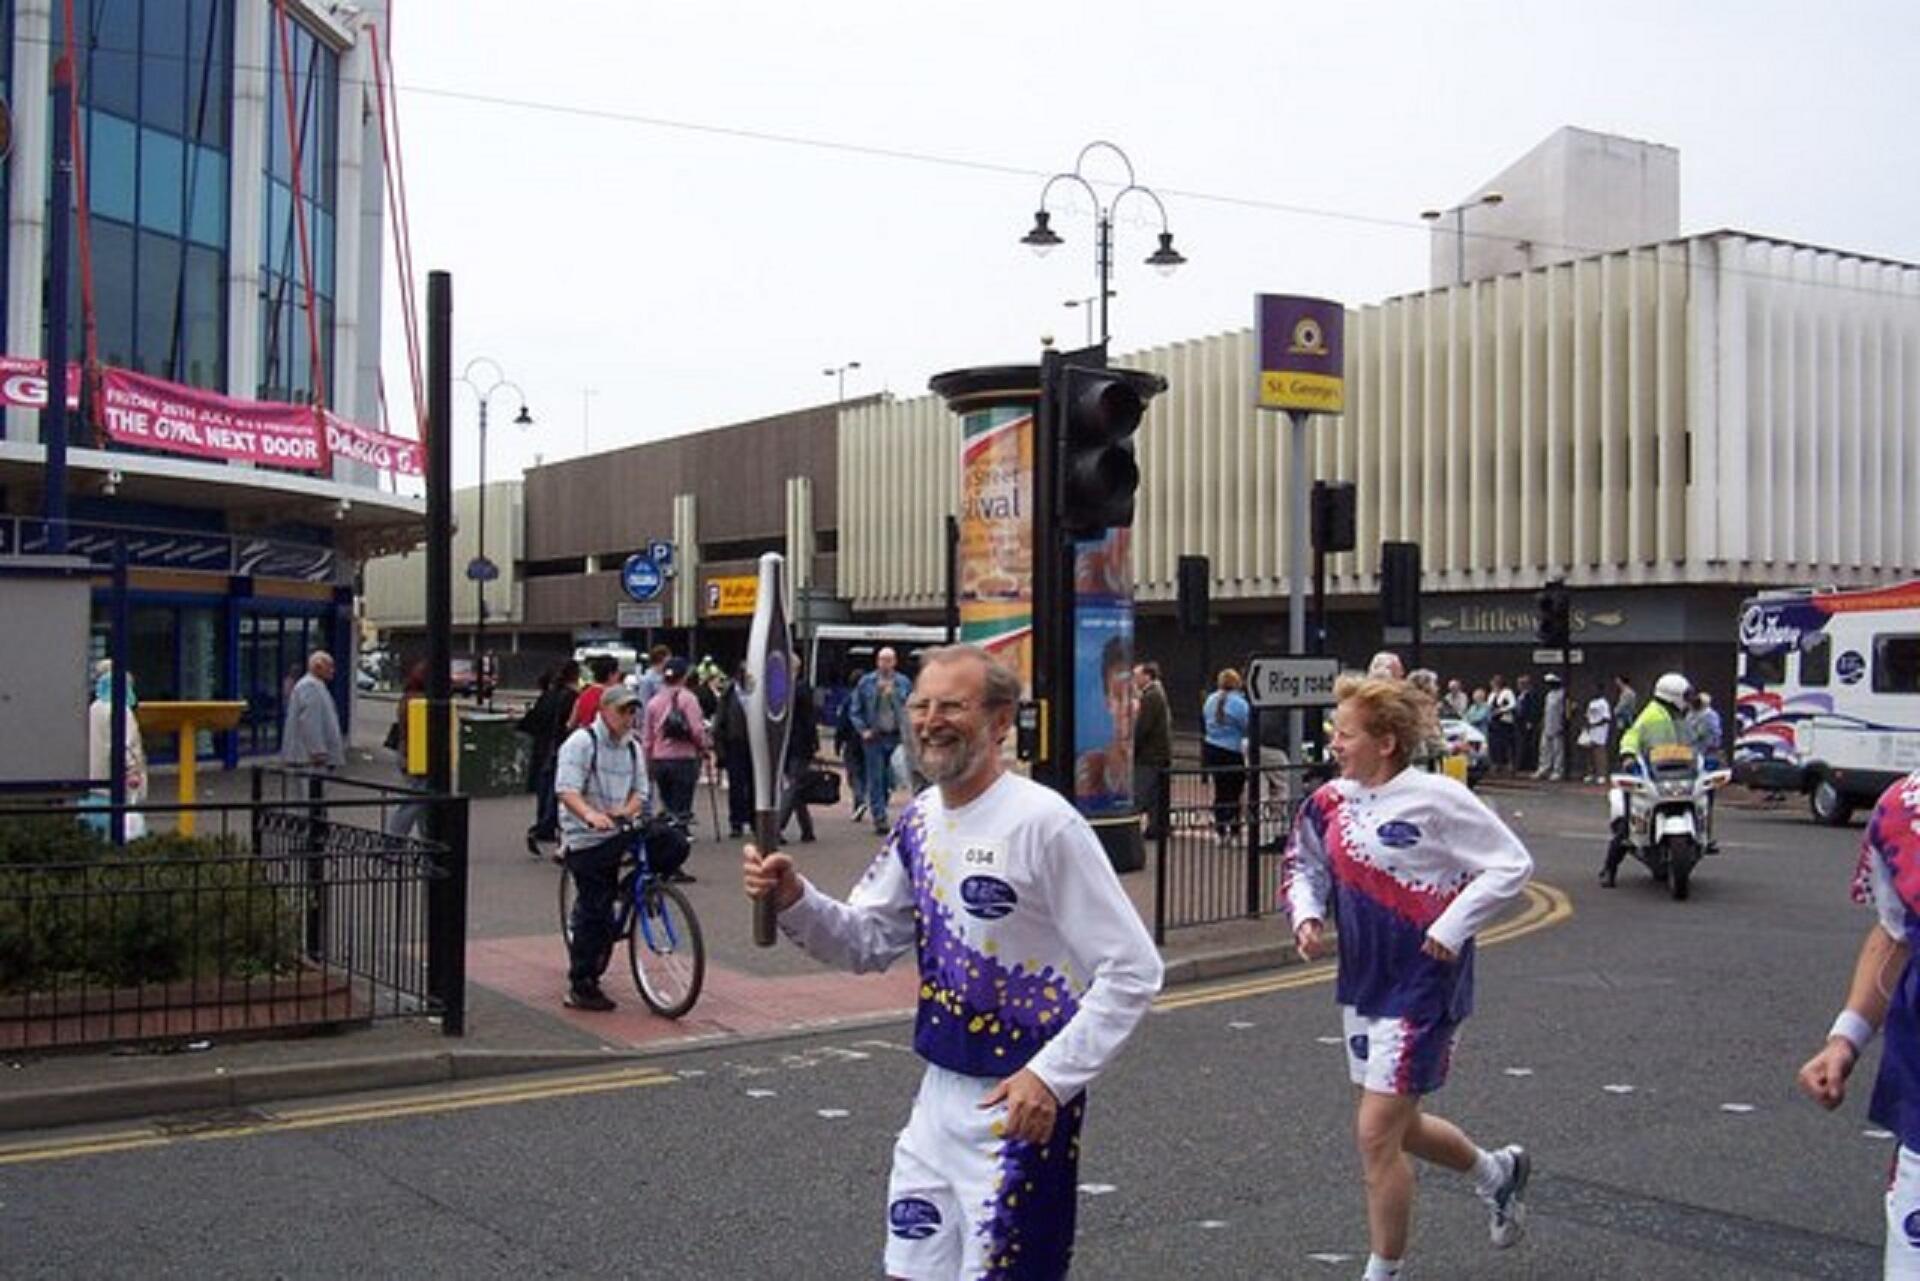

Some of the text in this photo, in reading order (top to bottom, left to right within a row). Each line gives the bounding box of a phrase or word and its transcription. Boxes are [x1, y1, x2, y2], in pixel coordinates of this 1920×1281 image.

[105, 407, 149, 436] THE
[204, 425, 256, 453] NEXT
[261, 434, 319, 461] DOOR
[1268, 671, 1334, 697] Ring road
